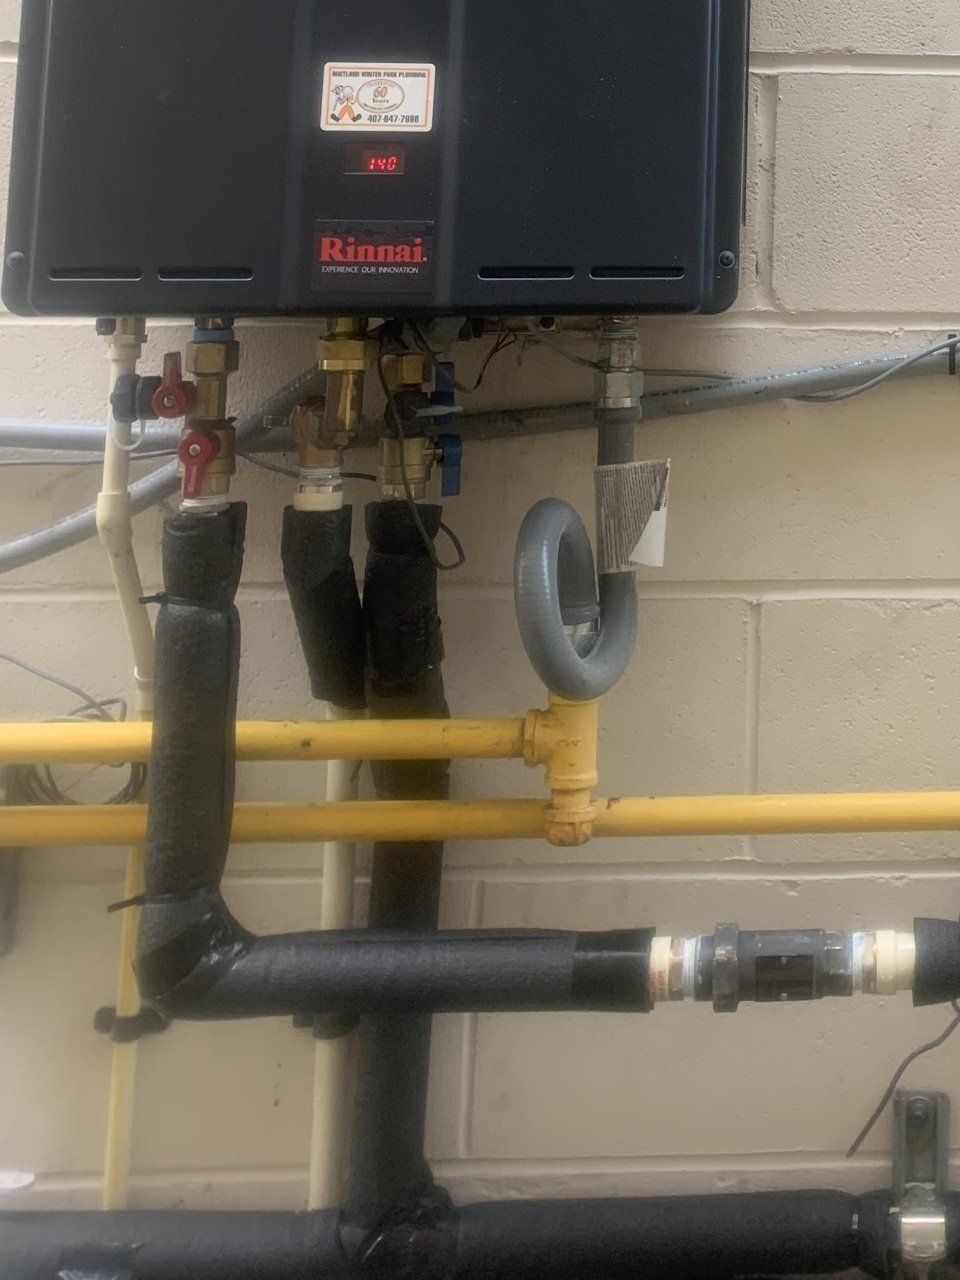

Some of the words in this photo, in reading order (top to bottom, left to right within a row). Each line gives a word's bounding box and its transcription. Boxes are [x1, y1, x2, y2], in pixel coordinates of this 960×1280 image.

[373, 86, 388, 98] 60
[369, 156, 398, 171] 140
[319, 236, 423, 263] Rinnai
[321, 265, 359, 273] EXPERIENCE
[378, 266, 419, 274] INNOVATION
